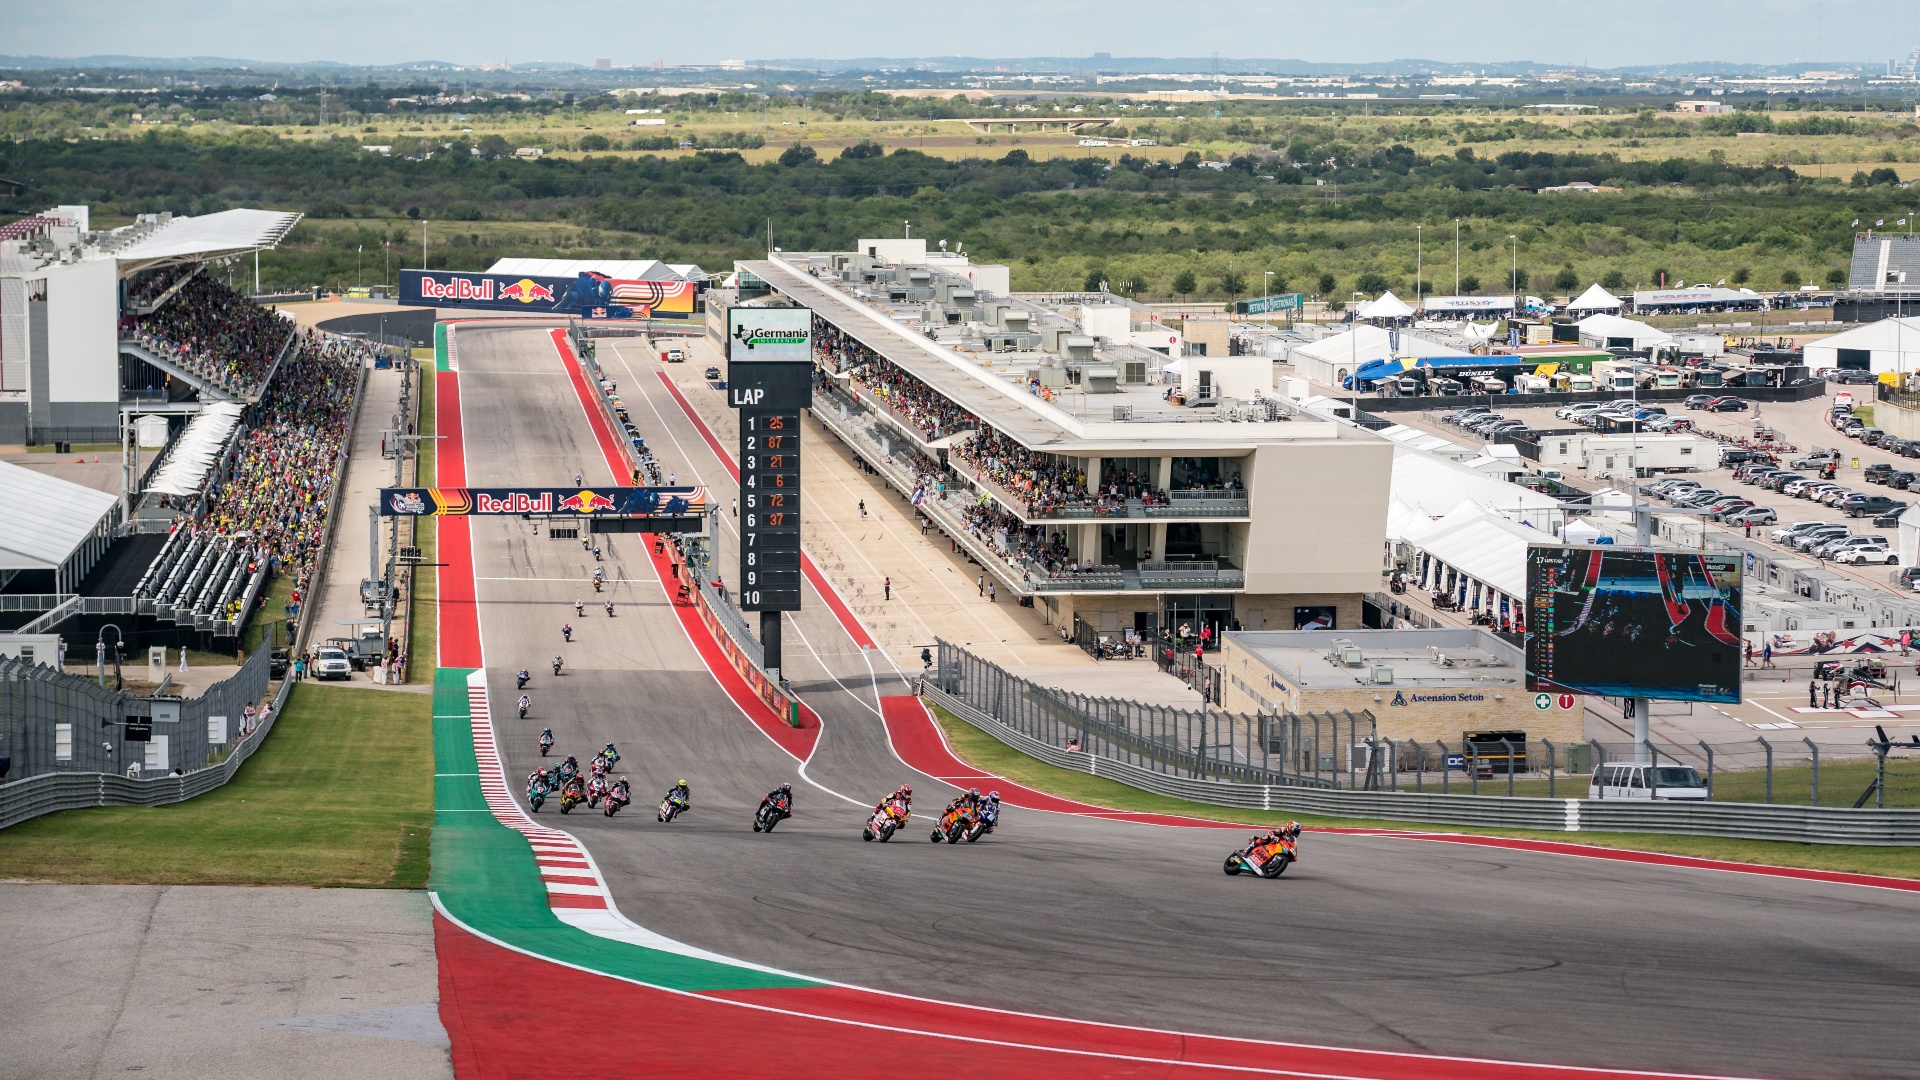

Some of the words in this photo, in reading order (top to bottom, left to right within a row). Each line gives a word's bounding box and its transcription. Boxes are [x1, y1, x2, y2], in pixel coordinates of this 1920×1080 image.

[1250, 302, 1269, 312] PETRONS
[754, 328, 808, 338] Germania
[734, 389, 764, 405] LAP
[748, 416, 754, 430] 1
[770, 416, 784, 430] 25
[748, 436, 756, 450] 2
[768, 436, 782, 448] 87
[748, 456, 756, 469] 3
[770, 456, 782, 468] 21
[747, 474, 756, 488] 4
[776, 475, 784, 487] 6
[748, 494, 756, 508] 5
[770, 494, 784, 506] 72
[748, 514, 756, 527] 6
[770, 513, 784, 526] 37
[748, 533, 756, 546] 7
[748, 552, 756, 566] 8
[748, 572, 756, 585] 9
[744, 591, 760, 604] 10
[1410, 694, 1456, 702] Ascension
[1458, 694, 1484, 702] Seton
[1564, 695, 1569, 707] T
